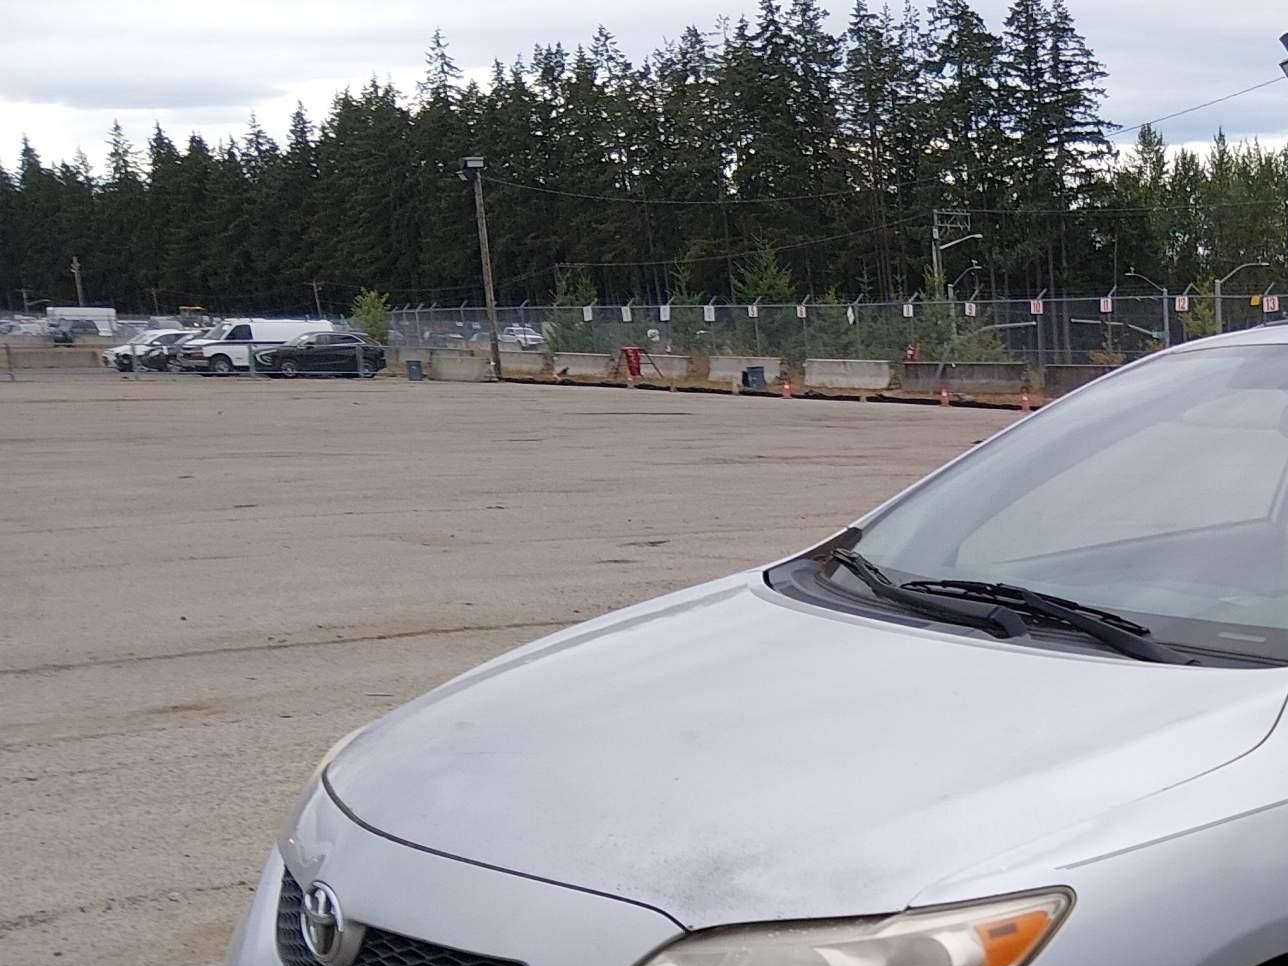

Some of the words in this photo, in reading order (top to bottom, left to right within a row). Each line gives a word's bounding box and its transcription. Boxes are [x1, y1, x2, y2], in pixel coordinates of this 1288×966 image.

[1033, 301, 1041, 313] 10
[1178, 297, 1186, 310] 12
[1266, 297, 1276, 310] 13
